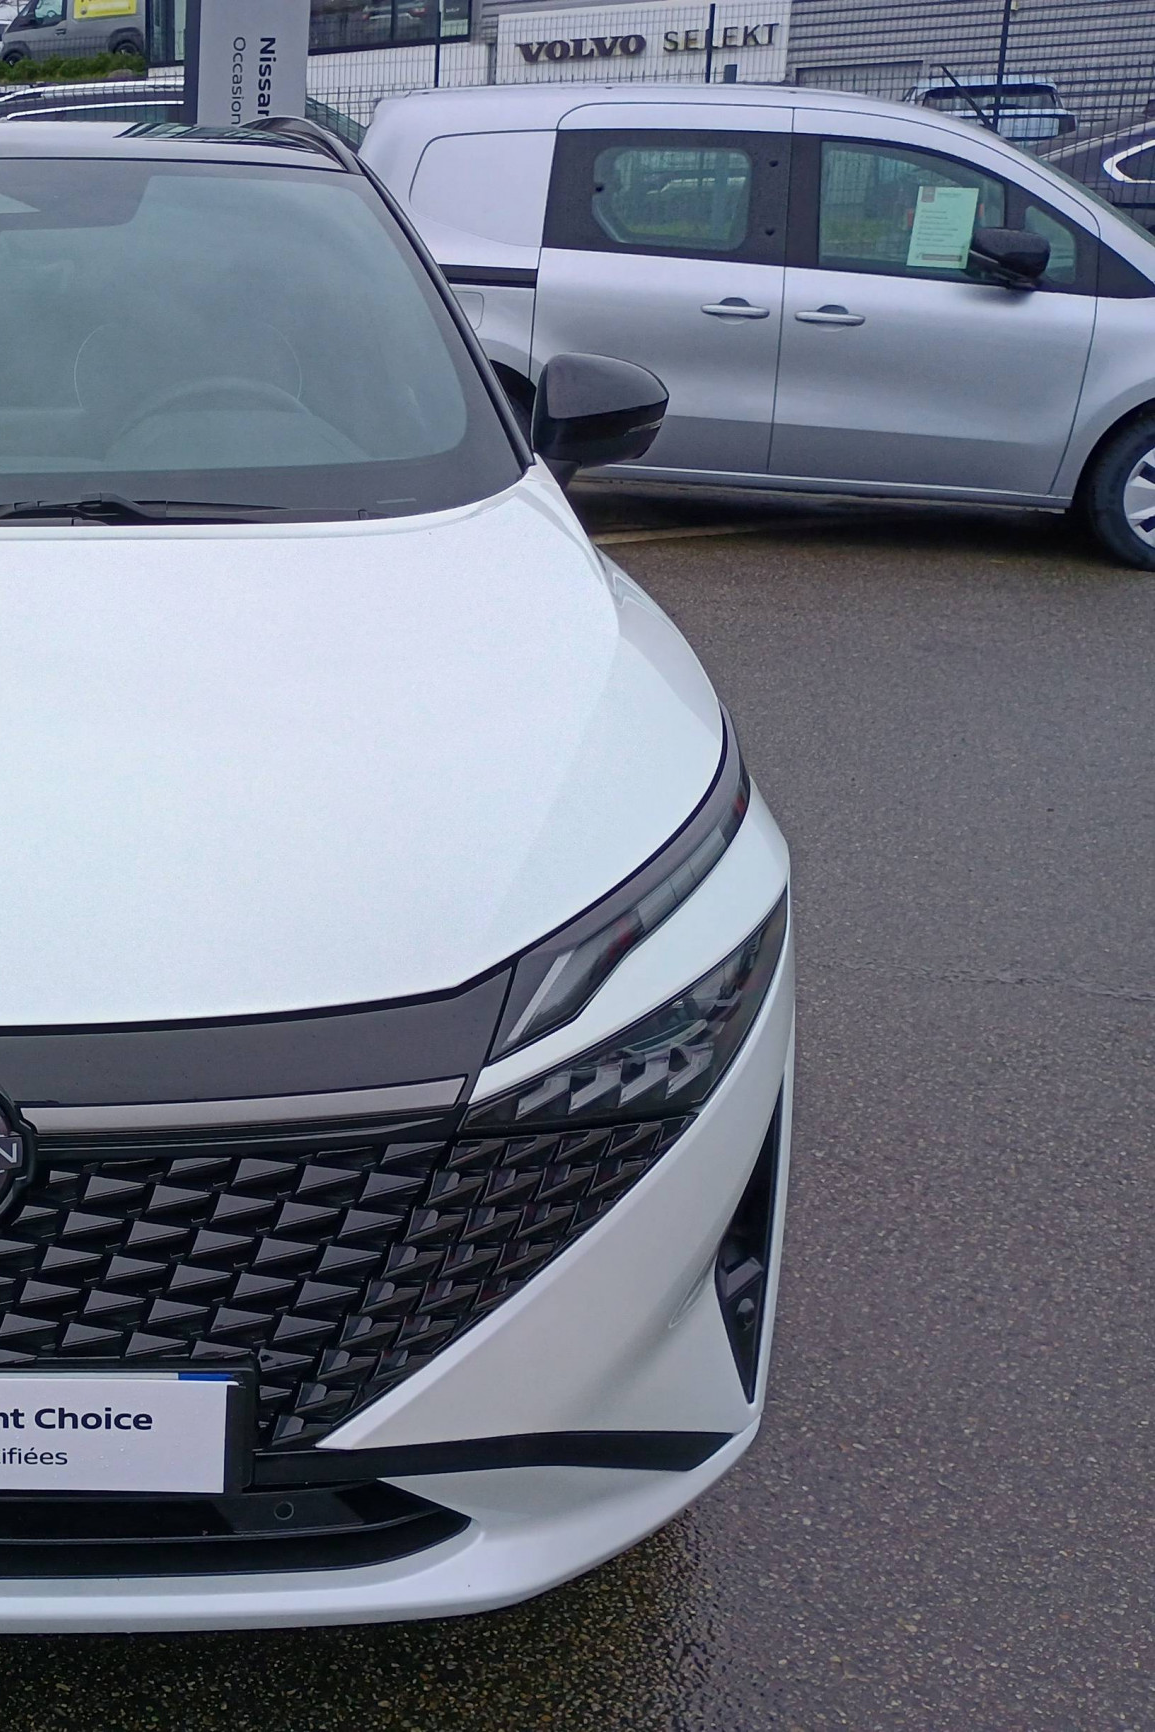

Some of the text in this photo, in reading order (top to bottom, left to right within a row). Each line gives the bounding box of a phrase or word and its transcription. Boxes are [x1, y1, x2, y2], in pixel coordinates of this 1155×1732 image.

[515, 23, 779, 63] VOLVO SELEKT
[231, 36, 246, 125] Occasion
[34, 1407, 153, 1431] Choice
